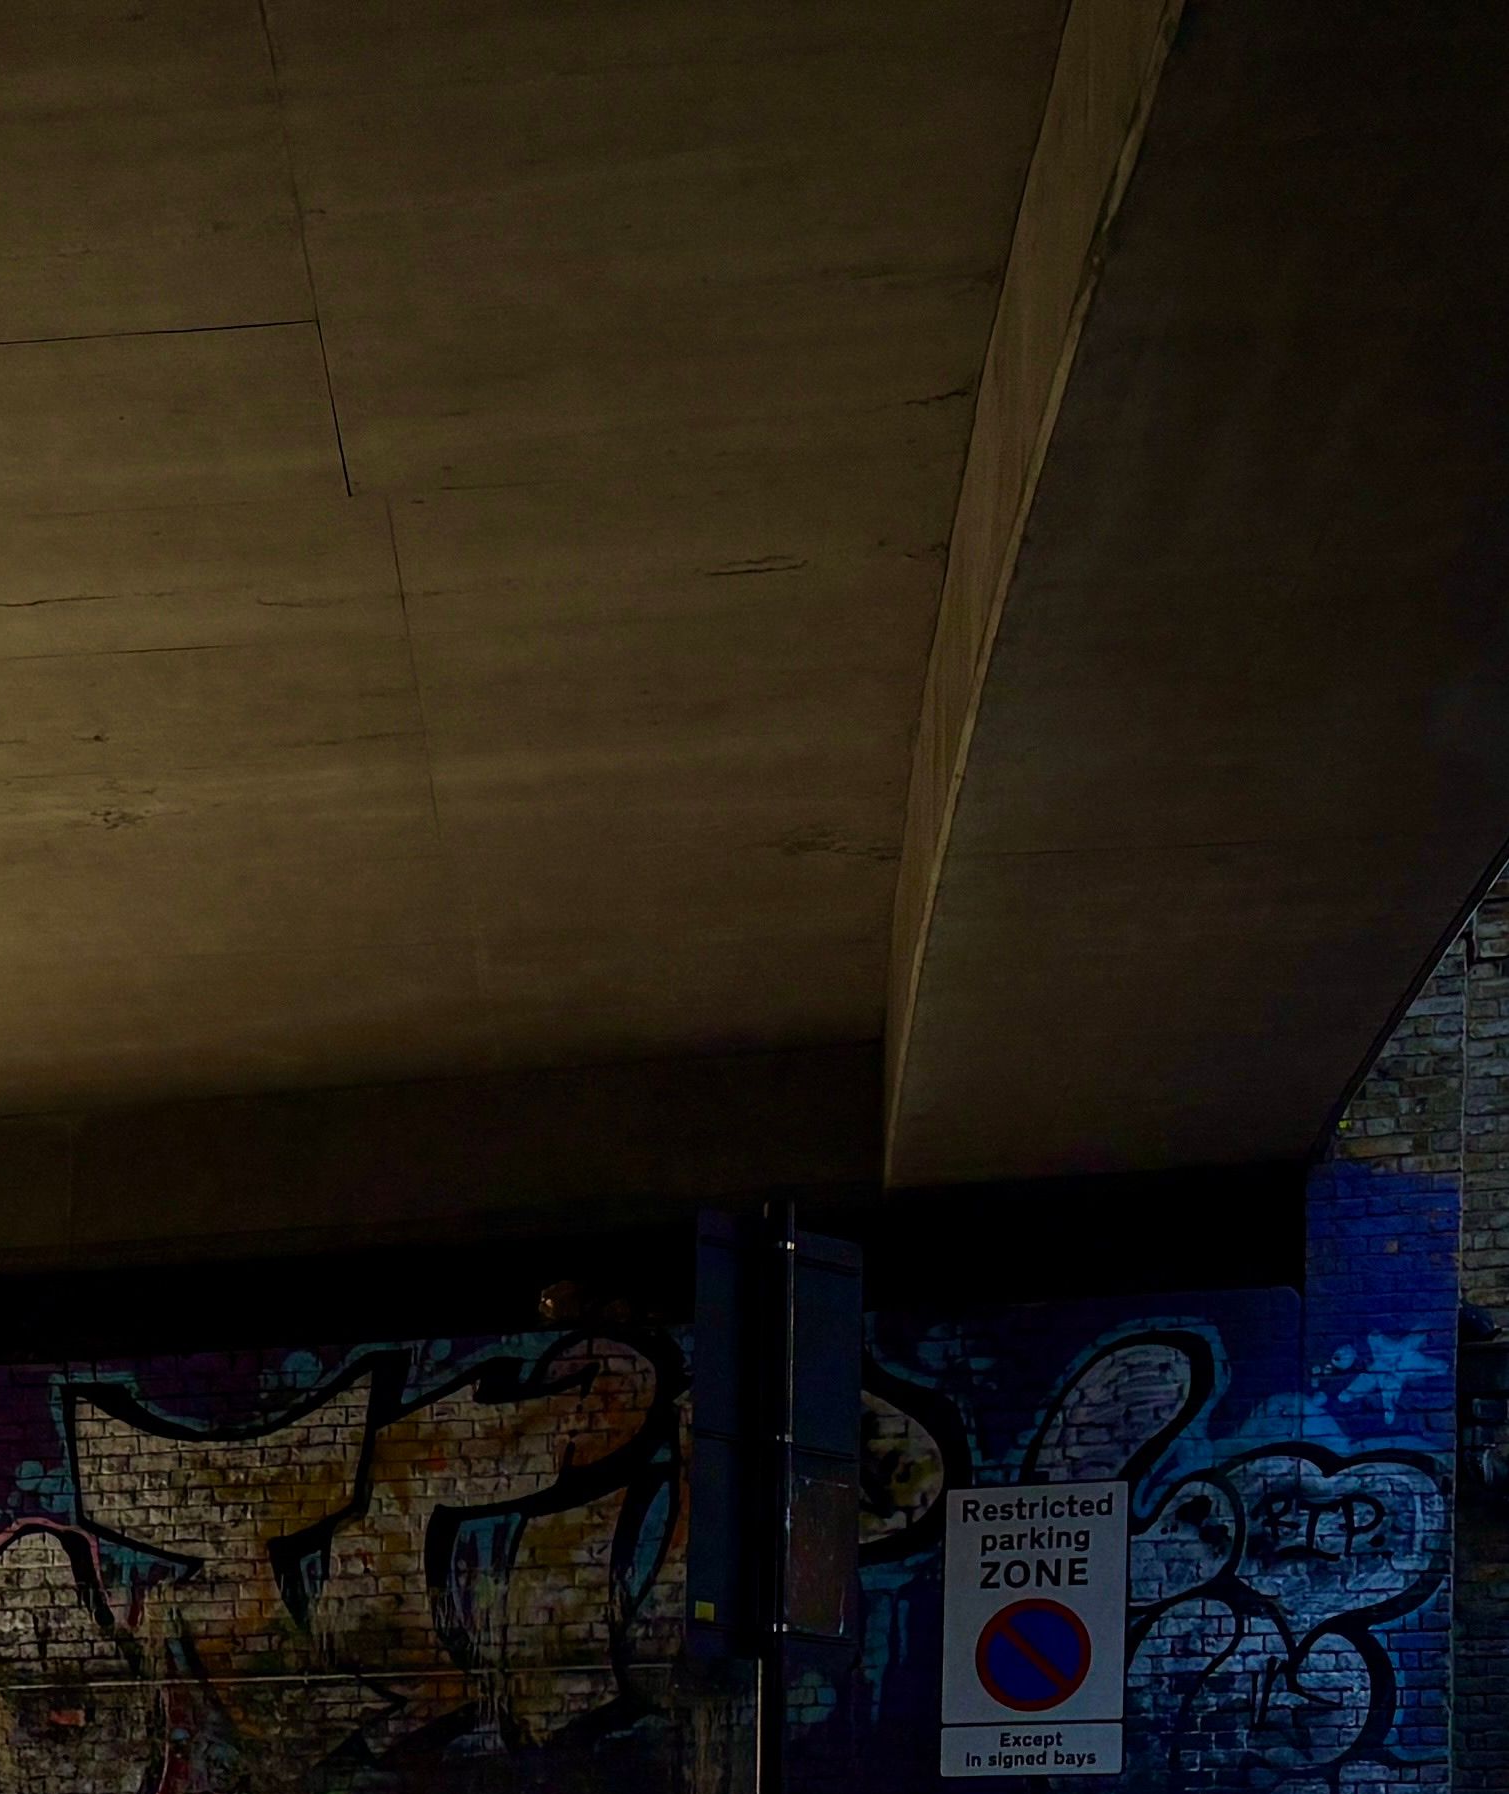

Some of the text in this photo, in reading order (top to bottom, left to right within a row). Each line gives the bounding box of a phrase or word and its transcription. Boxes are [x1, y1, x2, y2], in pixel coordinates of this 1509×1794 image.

[962, 1492, 1113, 1522] Restricted
[981, 1526, 1090, 1556] parking
[980, 1558, 1089, 1589] ZONE
[999, 1731, 1063, 1748] Except
[988, 1751, 1047, 1768] signed
[1054, 1750, 1096, 1768] bays
